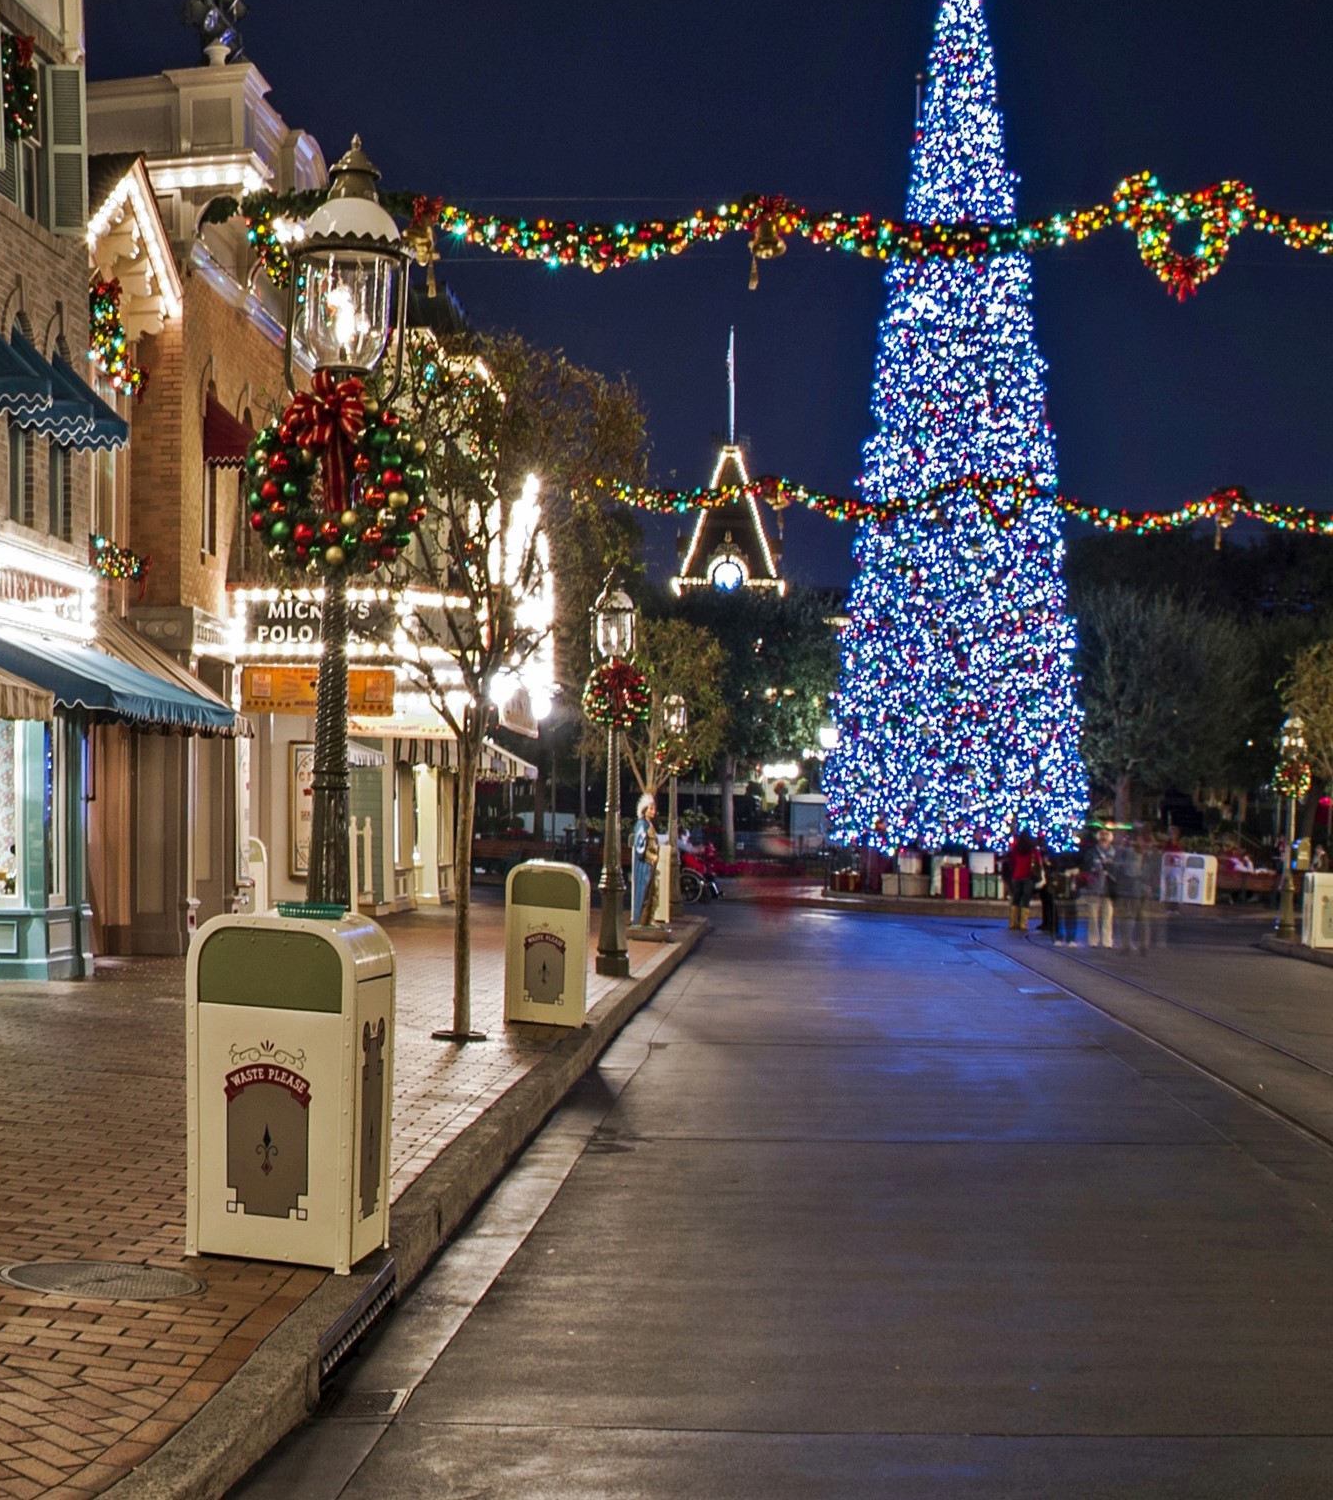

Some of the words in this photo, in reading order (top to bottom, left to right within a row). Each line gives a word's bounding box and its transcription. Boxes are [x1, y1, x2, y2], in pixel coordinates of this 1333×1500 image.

[257, 625, 313, 643] POLO
[230, 1068, 265, 1086] WASTE
[268, 1068, 307, 1094] PLEASE
